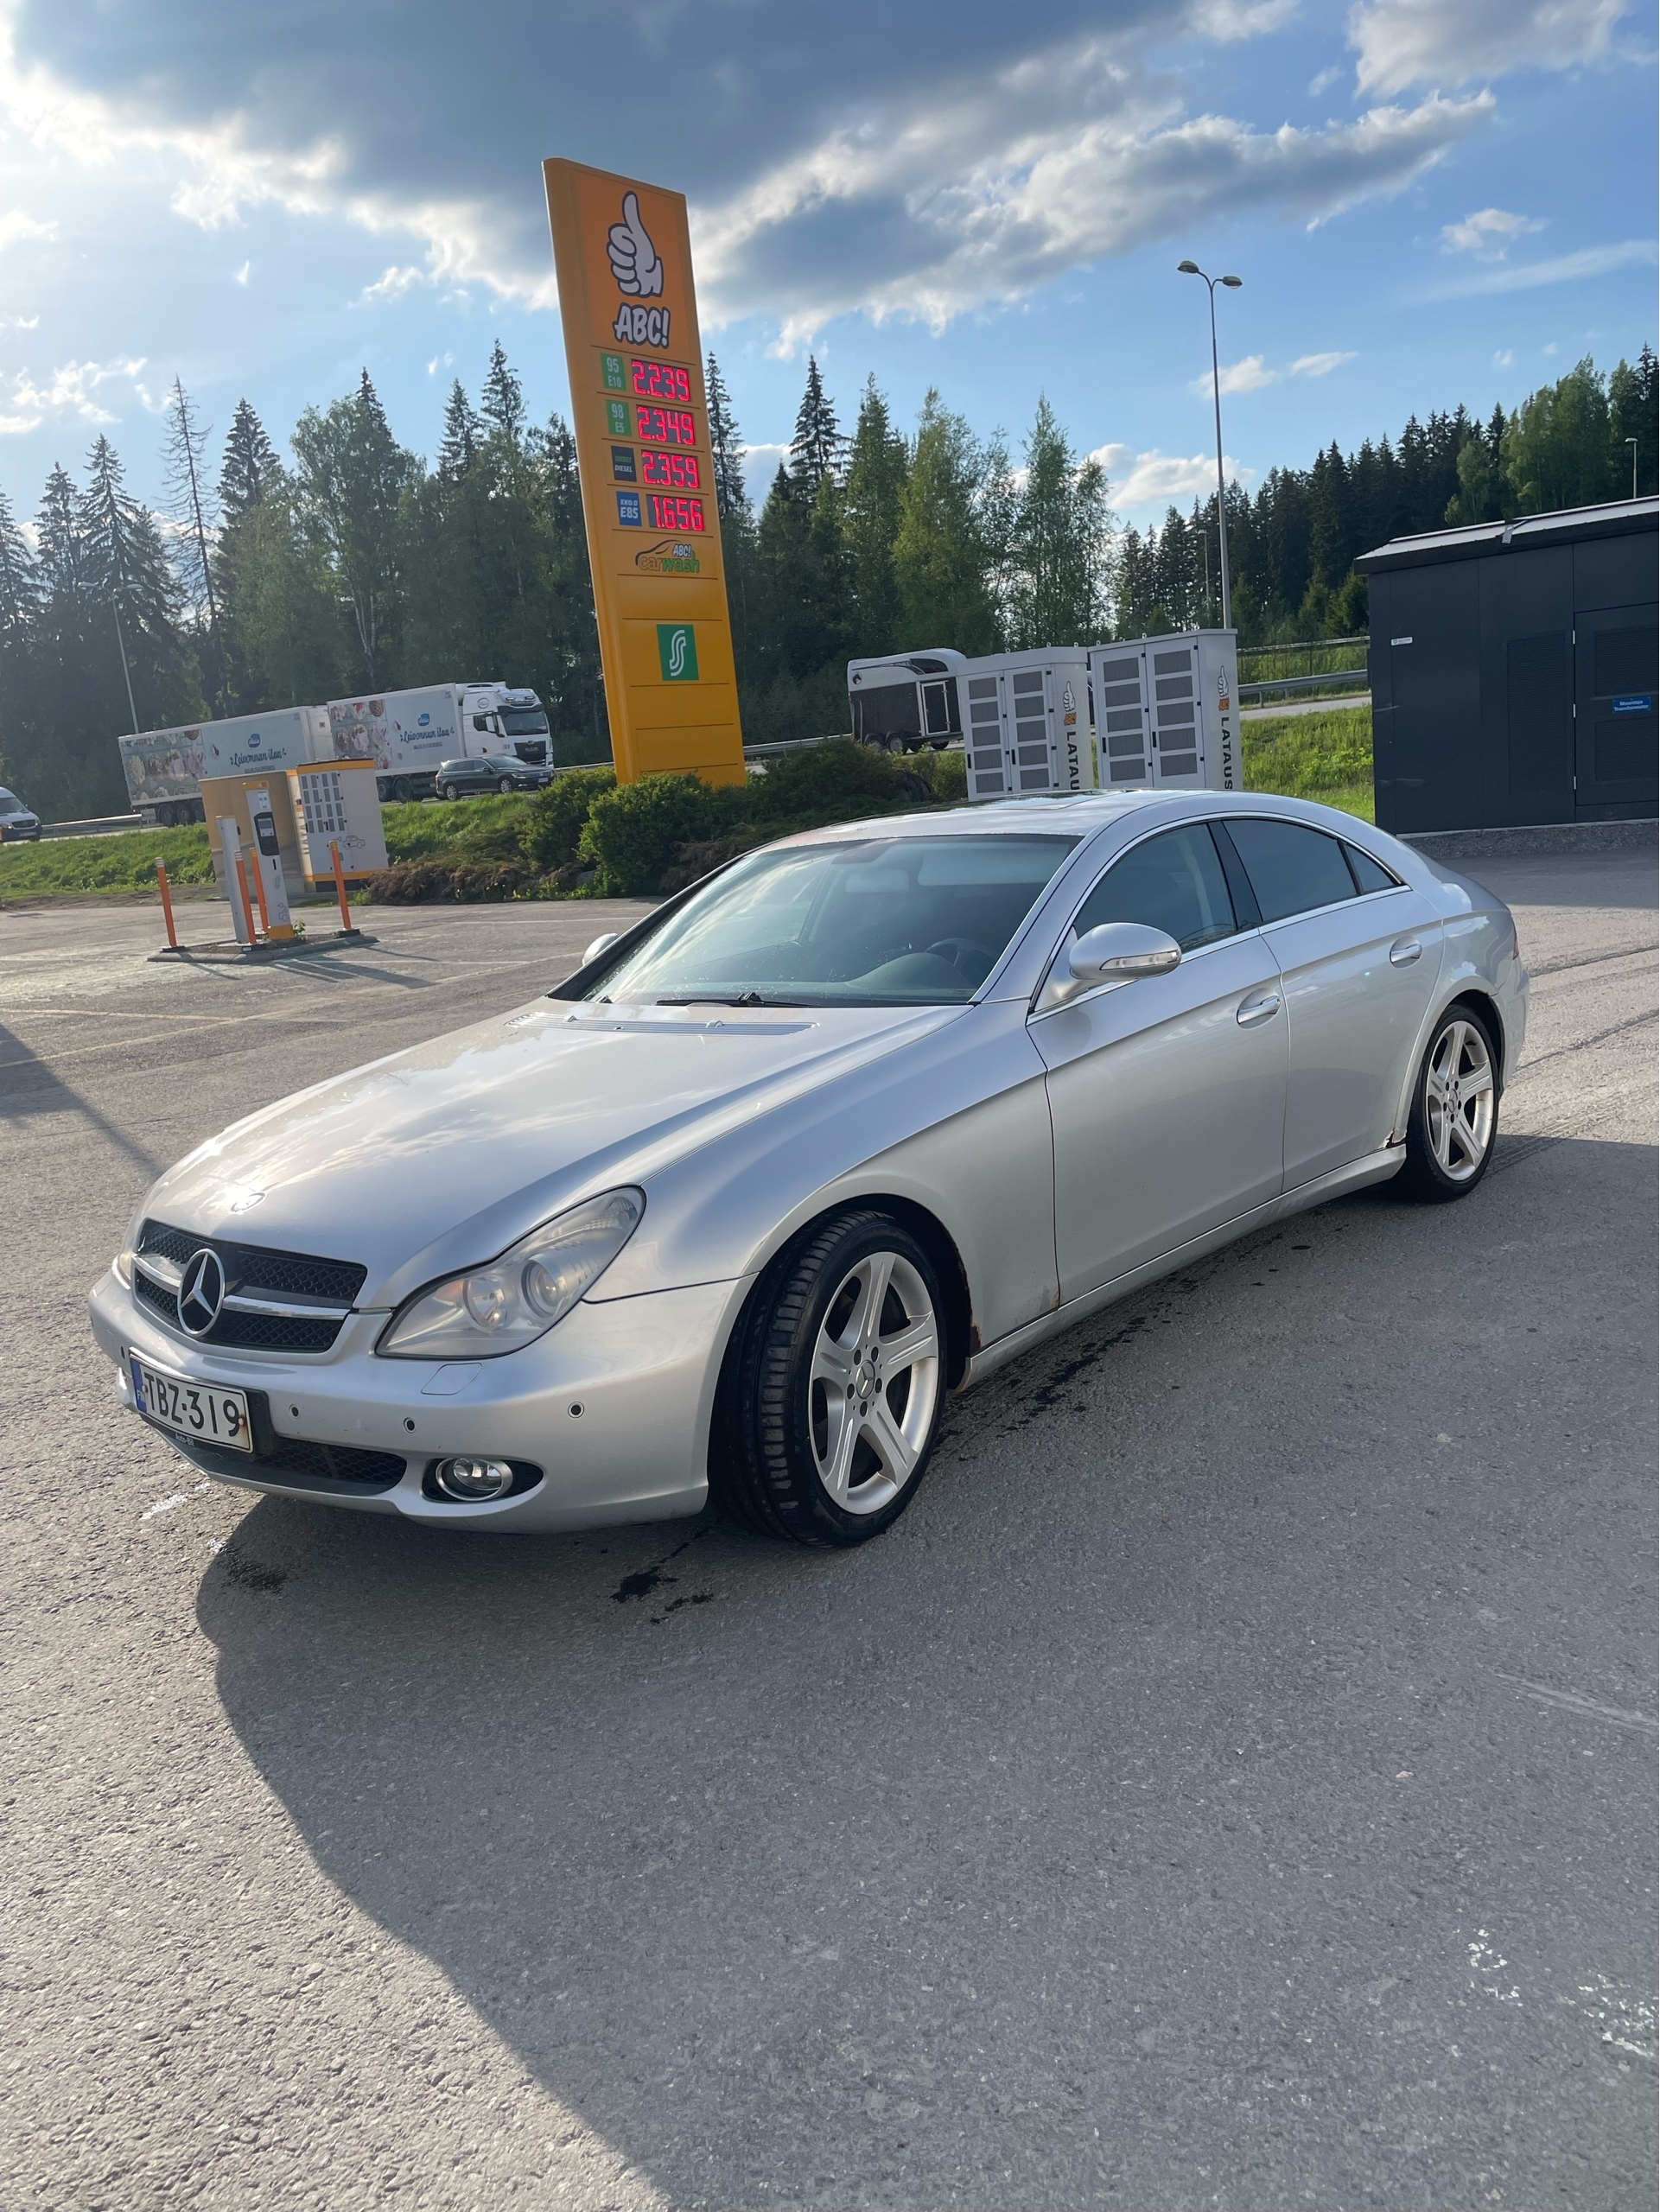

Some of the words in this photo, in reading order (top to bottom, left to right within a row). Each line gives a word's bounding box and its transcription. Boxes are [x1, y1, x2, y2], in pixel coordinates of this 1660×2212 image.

[613, 302, 671, 349] ABC!
[607, 357, 620, 372] 95
[607, 375, 622, 387] E10
[632, 360, 690, 401] 2.239
[611, 403, 624, 418] 98
[614, 421, 625, 433] E5
[637, 406, 696, 445] 2.349
[614, 464, 633, 473] DIESEL
[642, 451, 699, 488] 2.359
[620, 506, 639, 519] E85
[652, 496, 704, 531] 1.656
[672, 543, 692, 557] ABC!
[1221, 716, 1234, 790] LATAUS
[144, 1372, 239, 1437] TBZ-319
